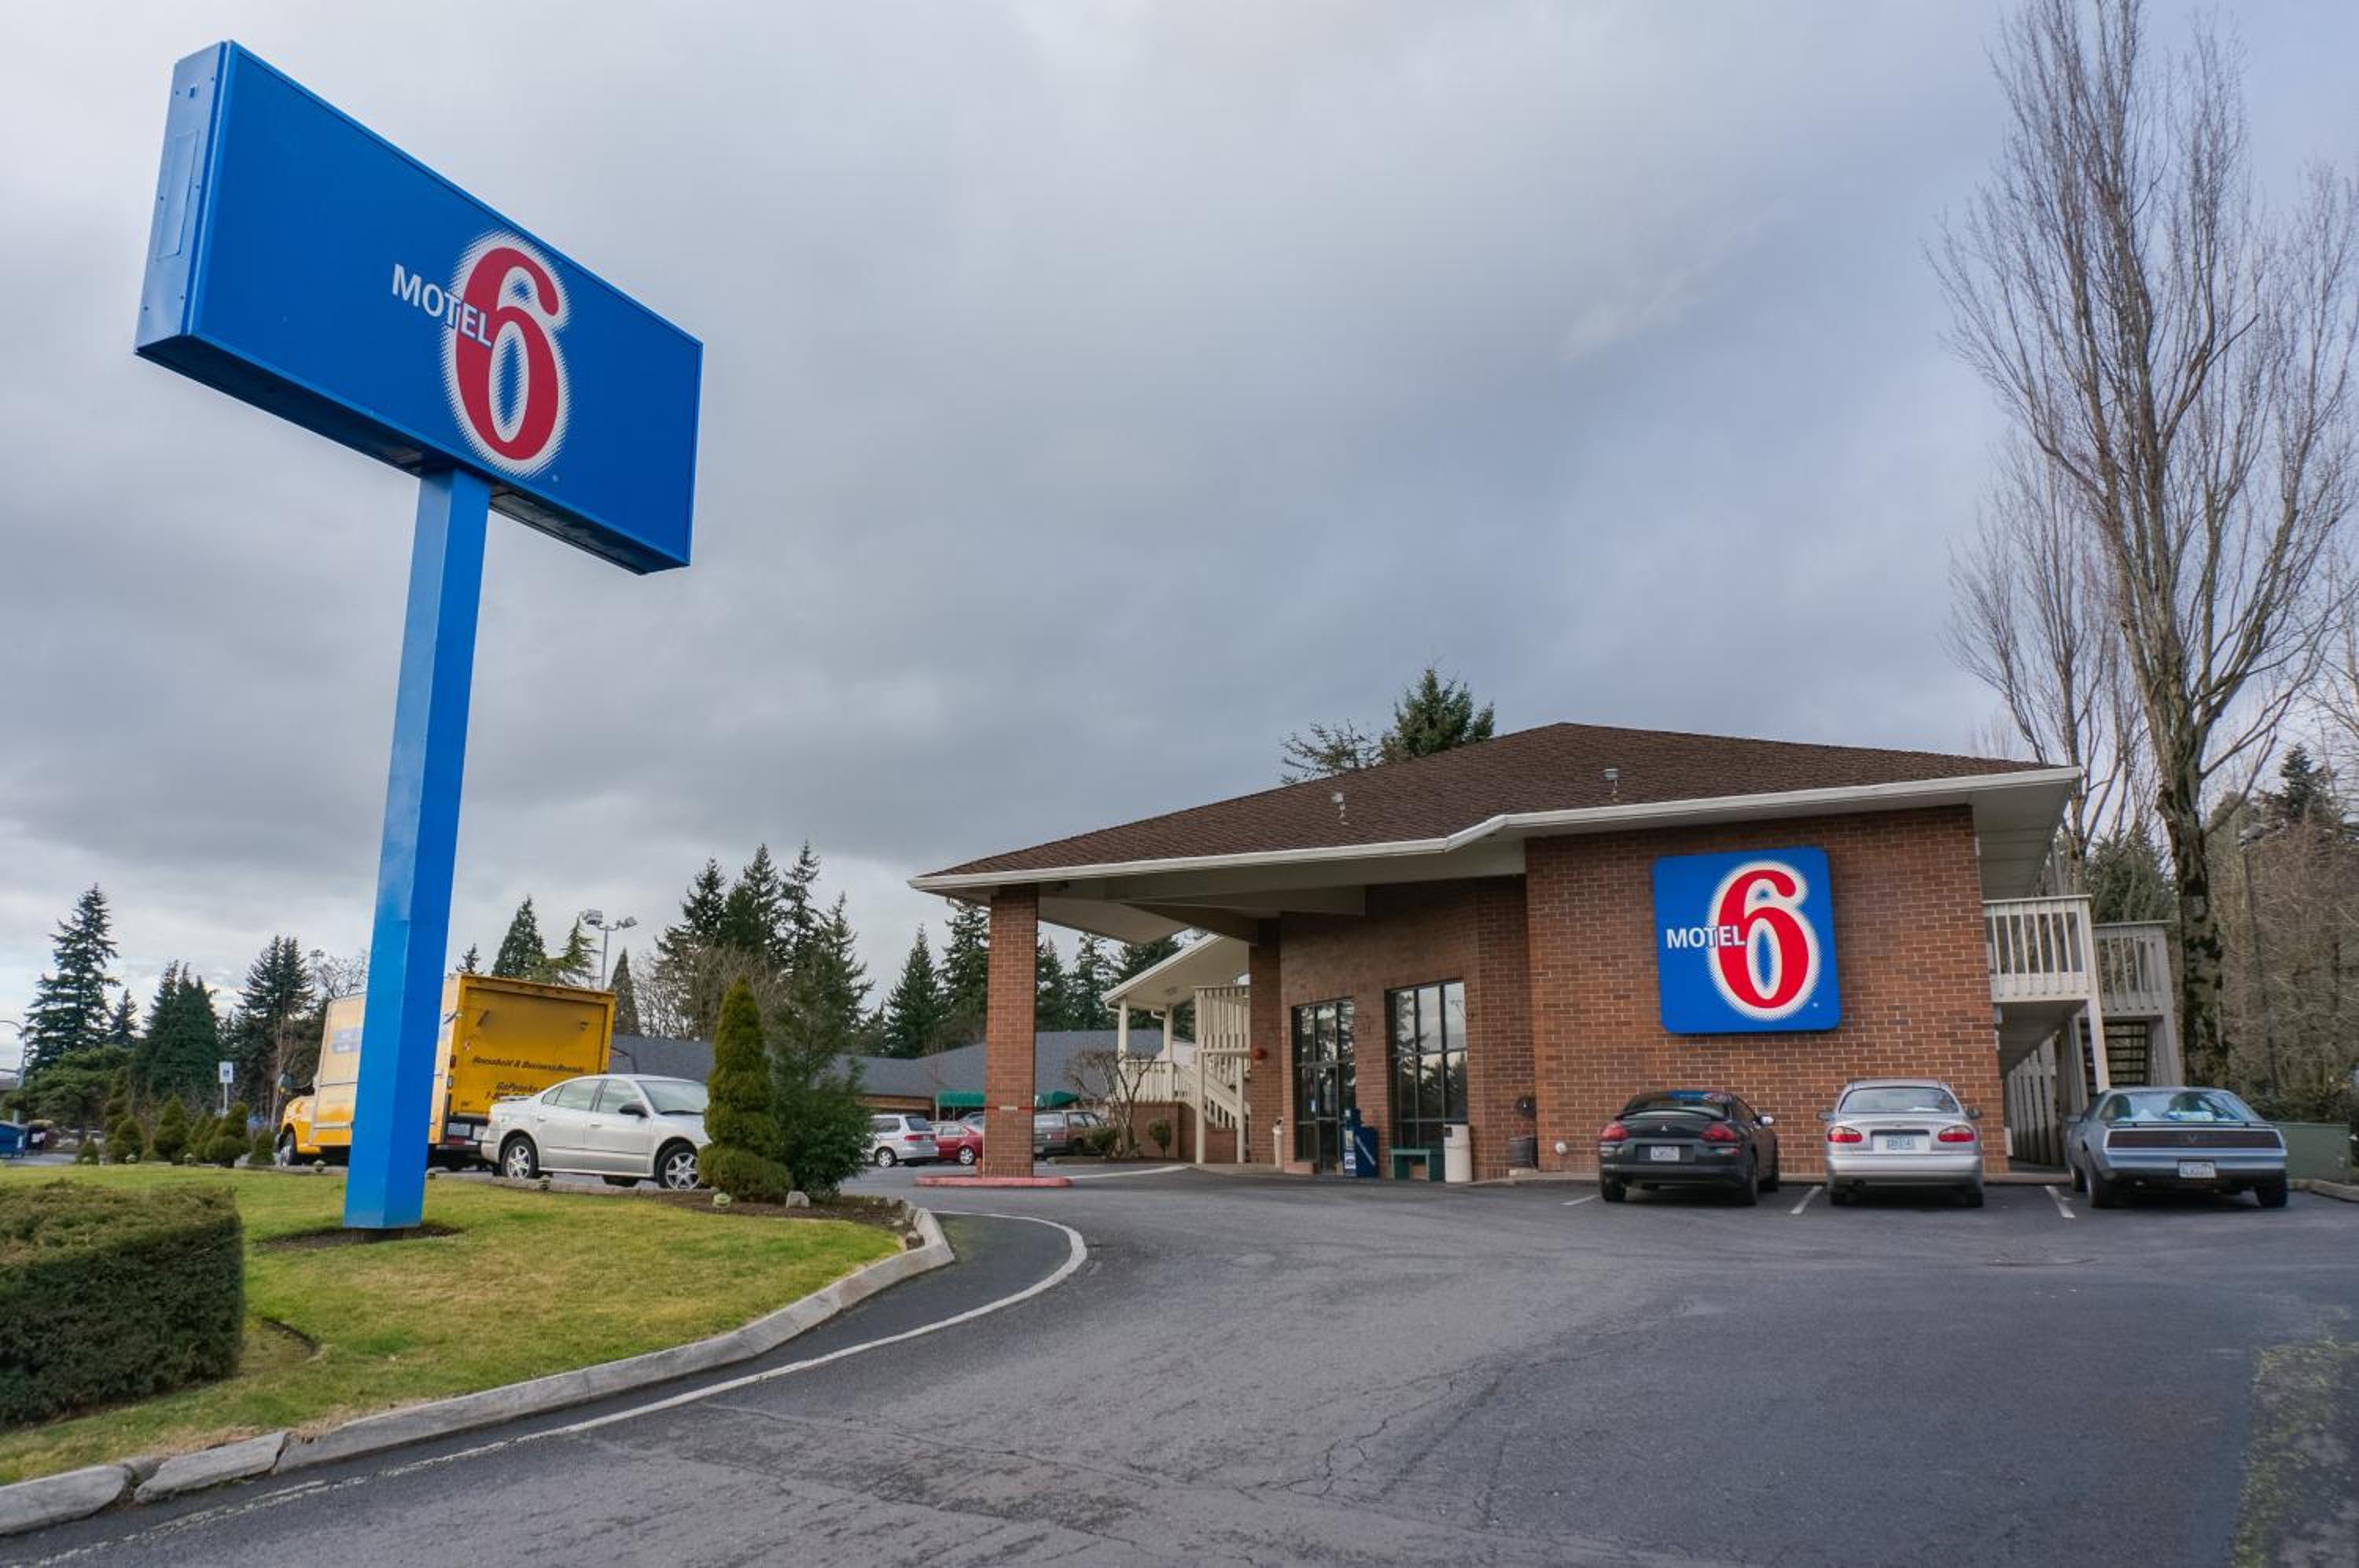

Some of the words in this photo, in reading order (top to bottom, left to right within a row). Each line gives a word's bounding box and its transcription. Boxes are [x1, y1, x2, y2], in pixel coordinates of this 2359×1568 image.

[392, 263, 491, 348] MOTEL
[455, 246, 560, 462] 6
[1665, 925, 1746, 949] MOTEL
[1717, 869, 1809, 1009] 6
